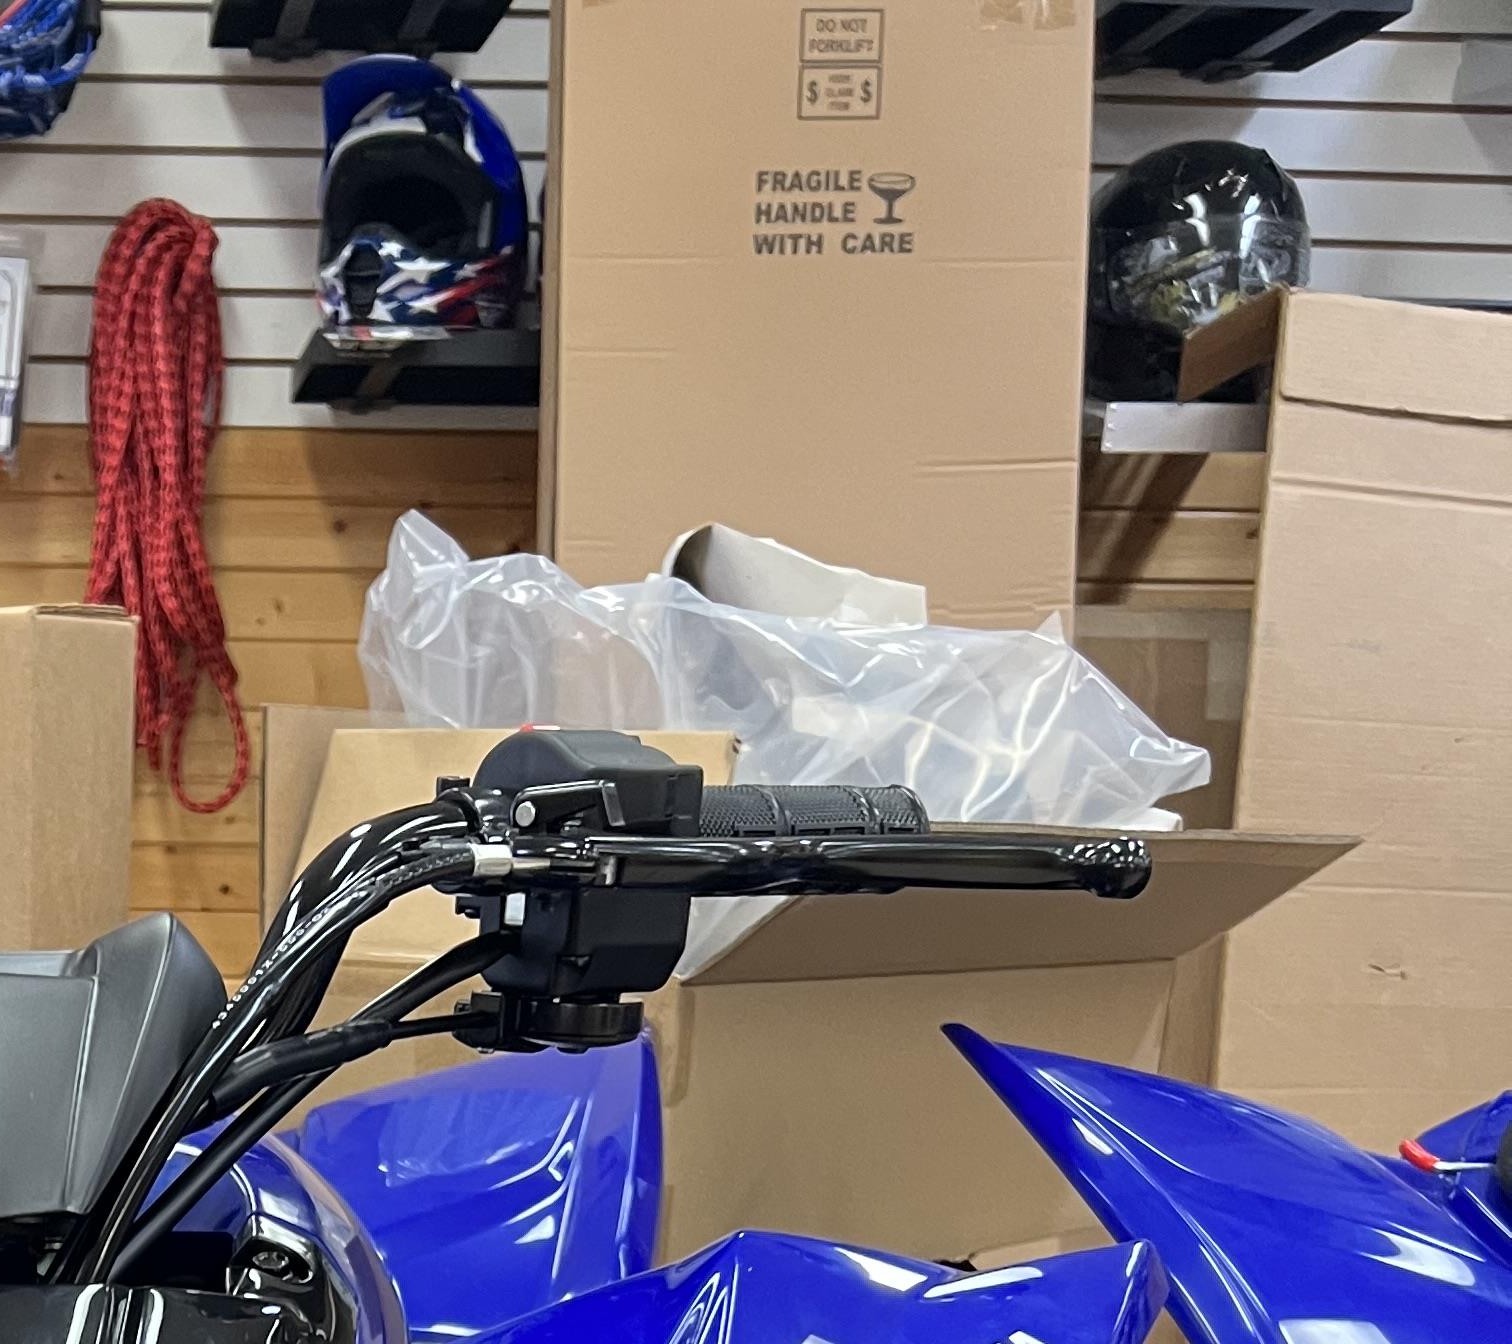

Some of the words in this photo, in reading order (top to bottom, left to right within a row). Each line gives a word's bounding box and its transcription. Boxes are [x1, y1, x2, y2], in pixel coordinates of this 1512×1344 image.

[816, 18, 835, 34] DO
[841, 18, 867, 34] NOT
[756, 170, 862, 193] FRAGILE
[754, 201, 857, 225] HANDLE
[752, 233, 824, 255] WITH
[841, 232, 914, 254] CARE
